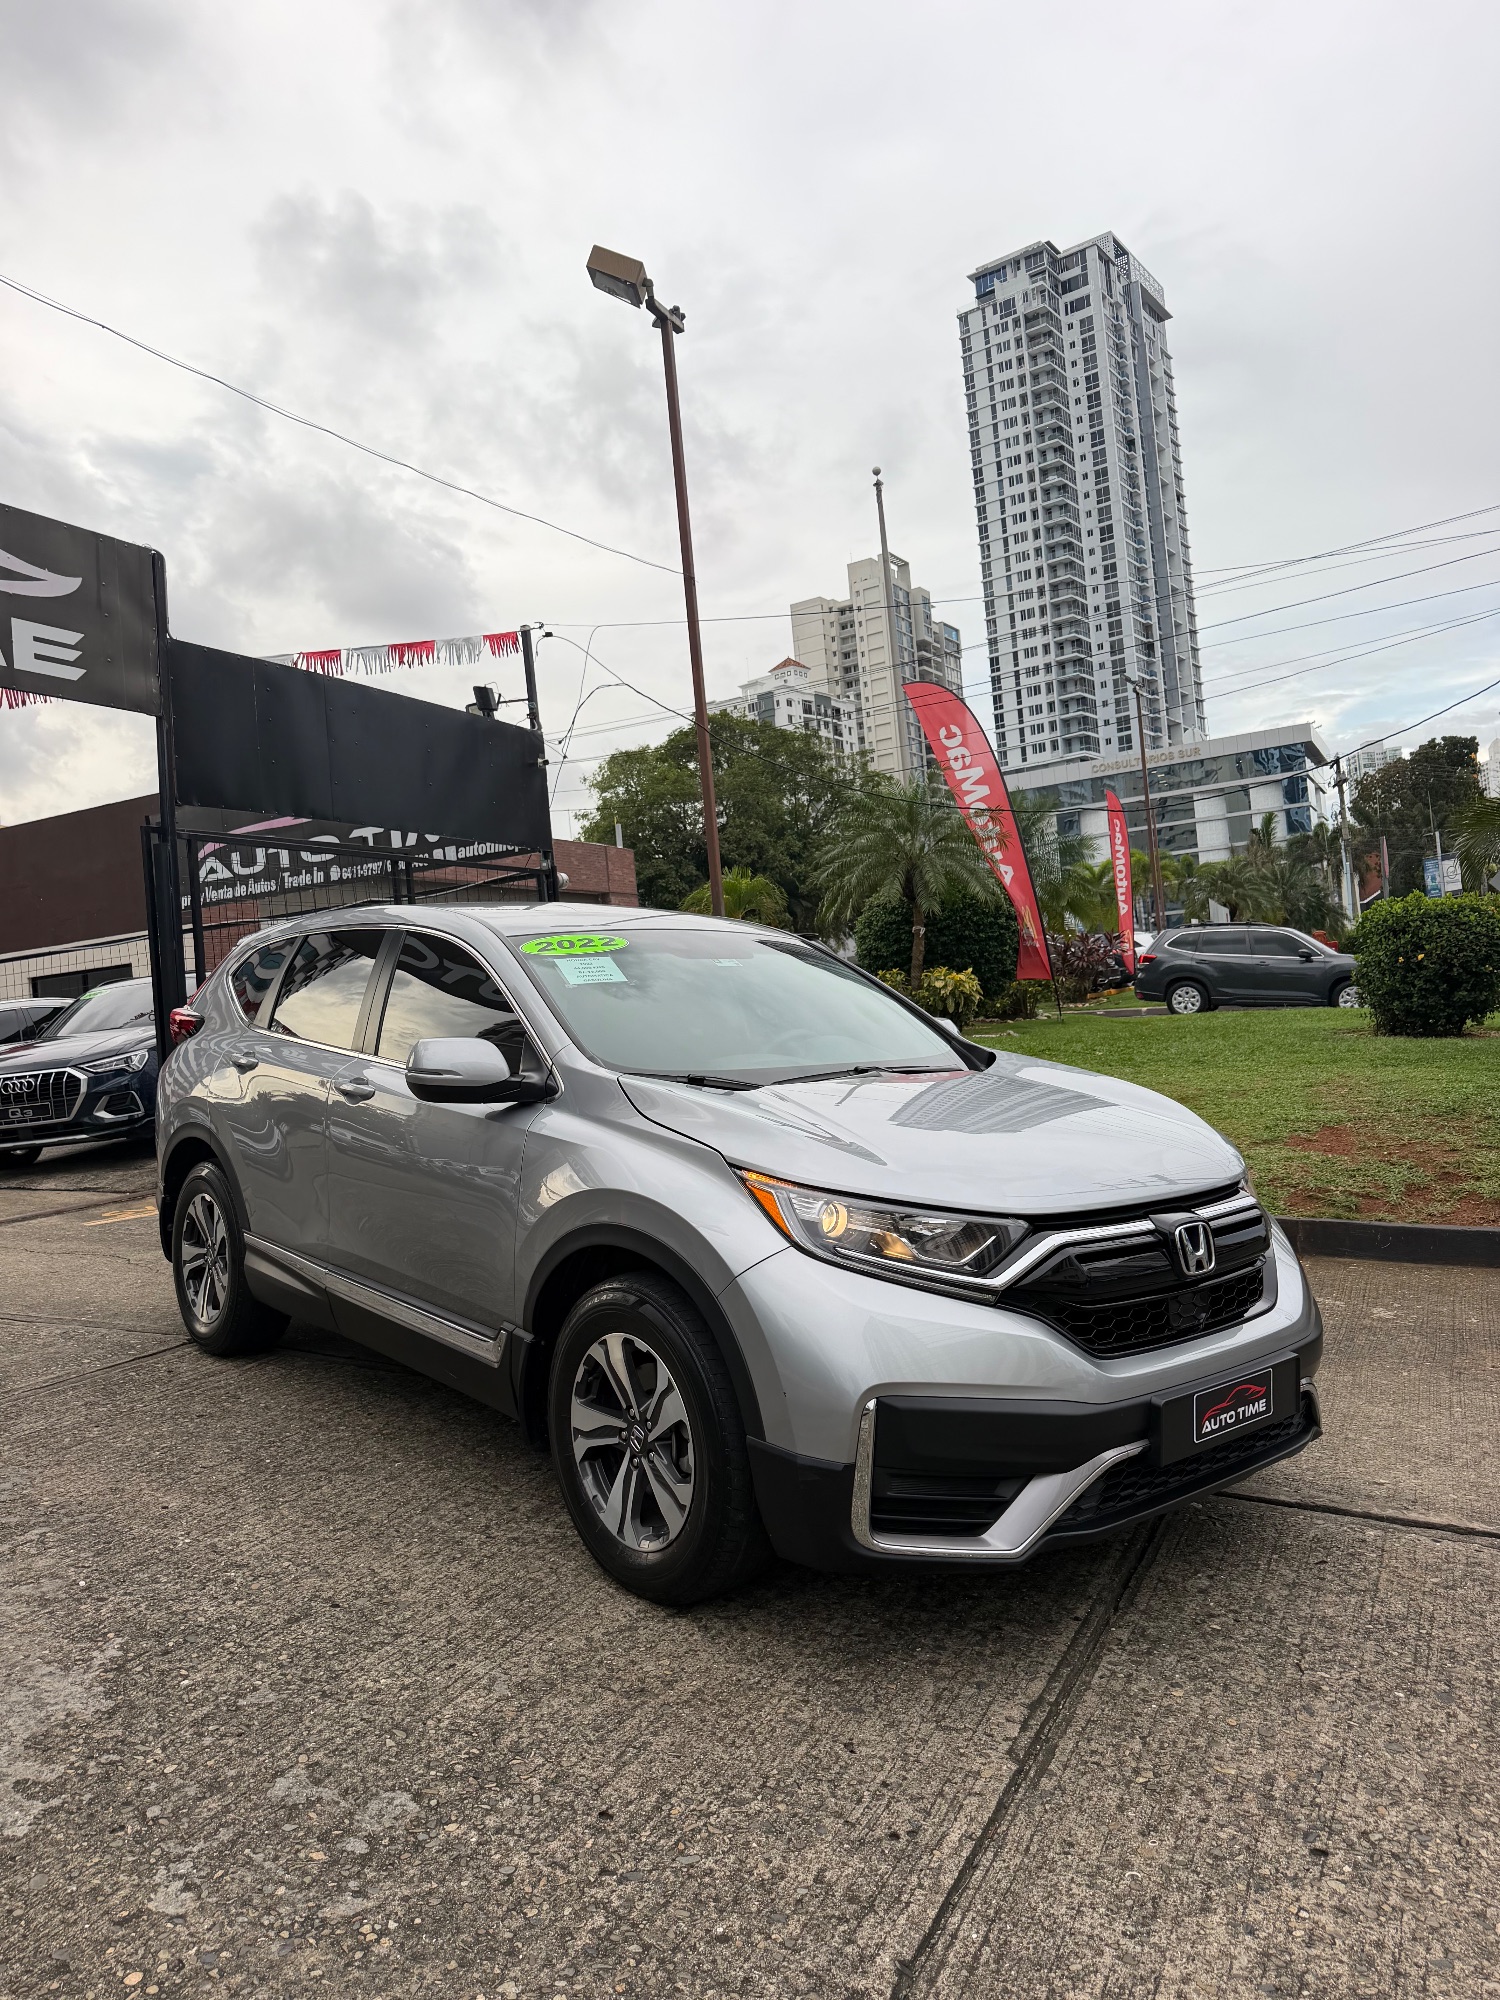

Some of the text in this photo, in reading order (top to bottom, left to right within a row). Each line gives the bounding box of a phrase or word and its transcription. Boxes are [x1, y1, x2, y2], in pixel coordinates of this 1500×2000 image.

[0, 616, 87, 681] E
[1092, 746, 1202, 774] CONSULTRIOS SUR
[205, 884, 233, 903] Venta
[234, 881, 247, 897] de
[247, 878, 277, 896] Autos
[282, 869, 312, 889] Trade
[341, 860, 382, 880] 6411-9797
[534, 937, 620, 953] 2022
[8, 1108, 33, 1119] Q3
[1201, 1398, 1267, 1434] AUTO TIME
